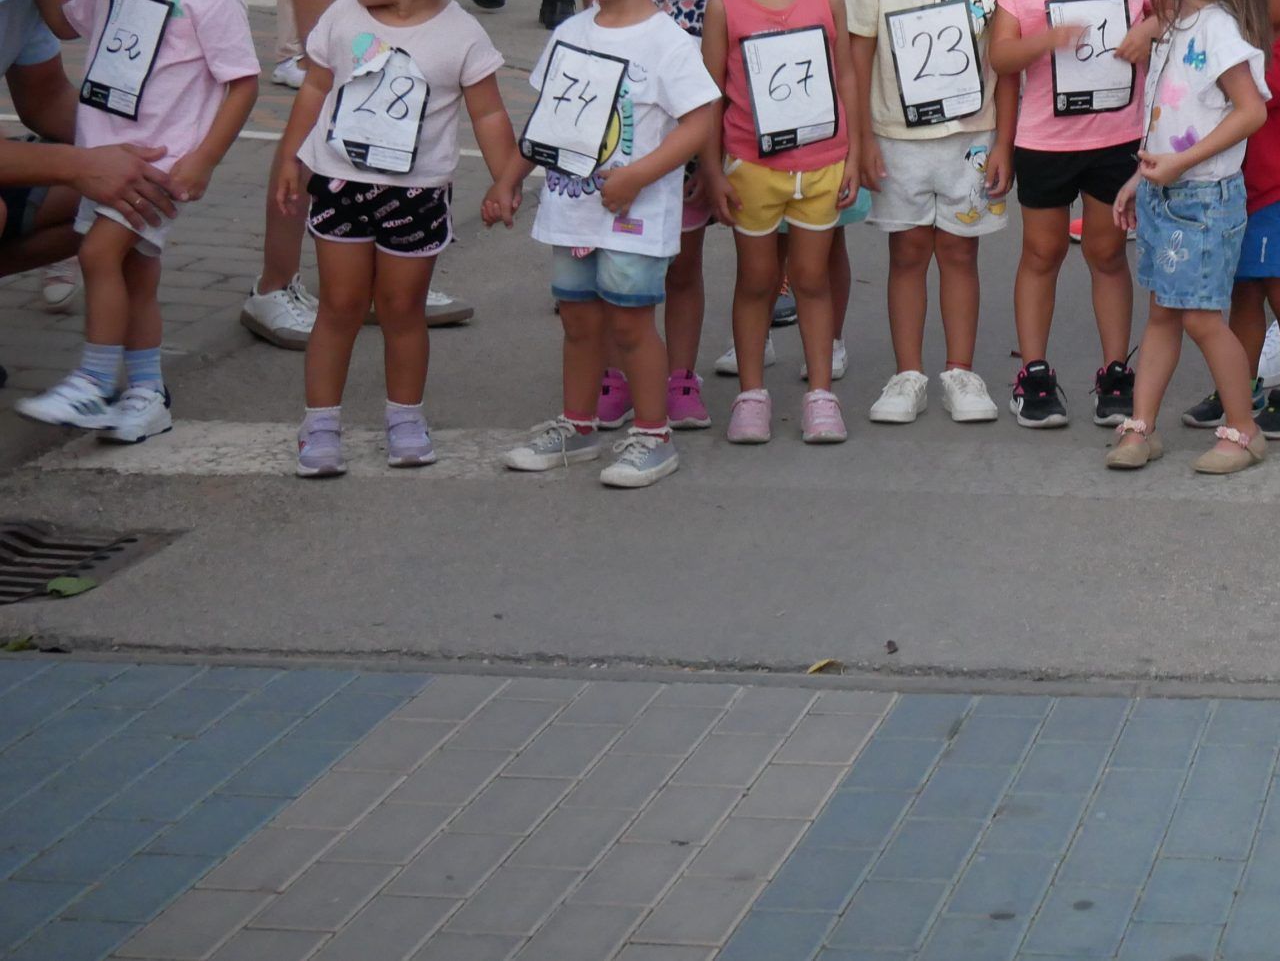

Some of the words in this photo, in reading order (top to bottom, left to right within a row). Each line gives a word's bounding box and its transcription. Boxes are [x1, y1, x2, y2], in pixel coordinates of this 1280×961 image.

[106, 28, 141, 61] 52
[911, 25, 970, 81] 23
[1075, 18, 1118, 62] 61
[353, 67, 415, 121] 28
[552, 70, 598, 128] 74
[768, 59, 814, 102] 67
